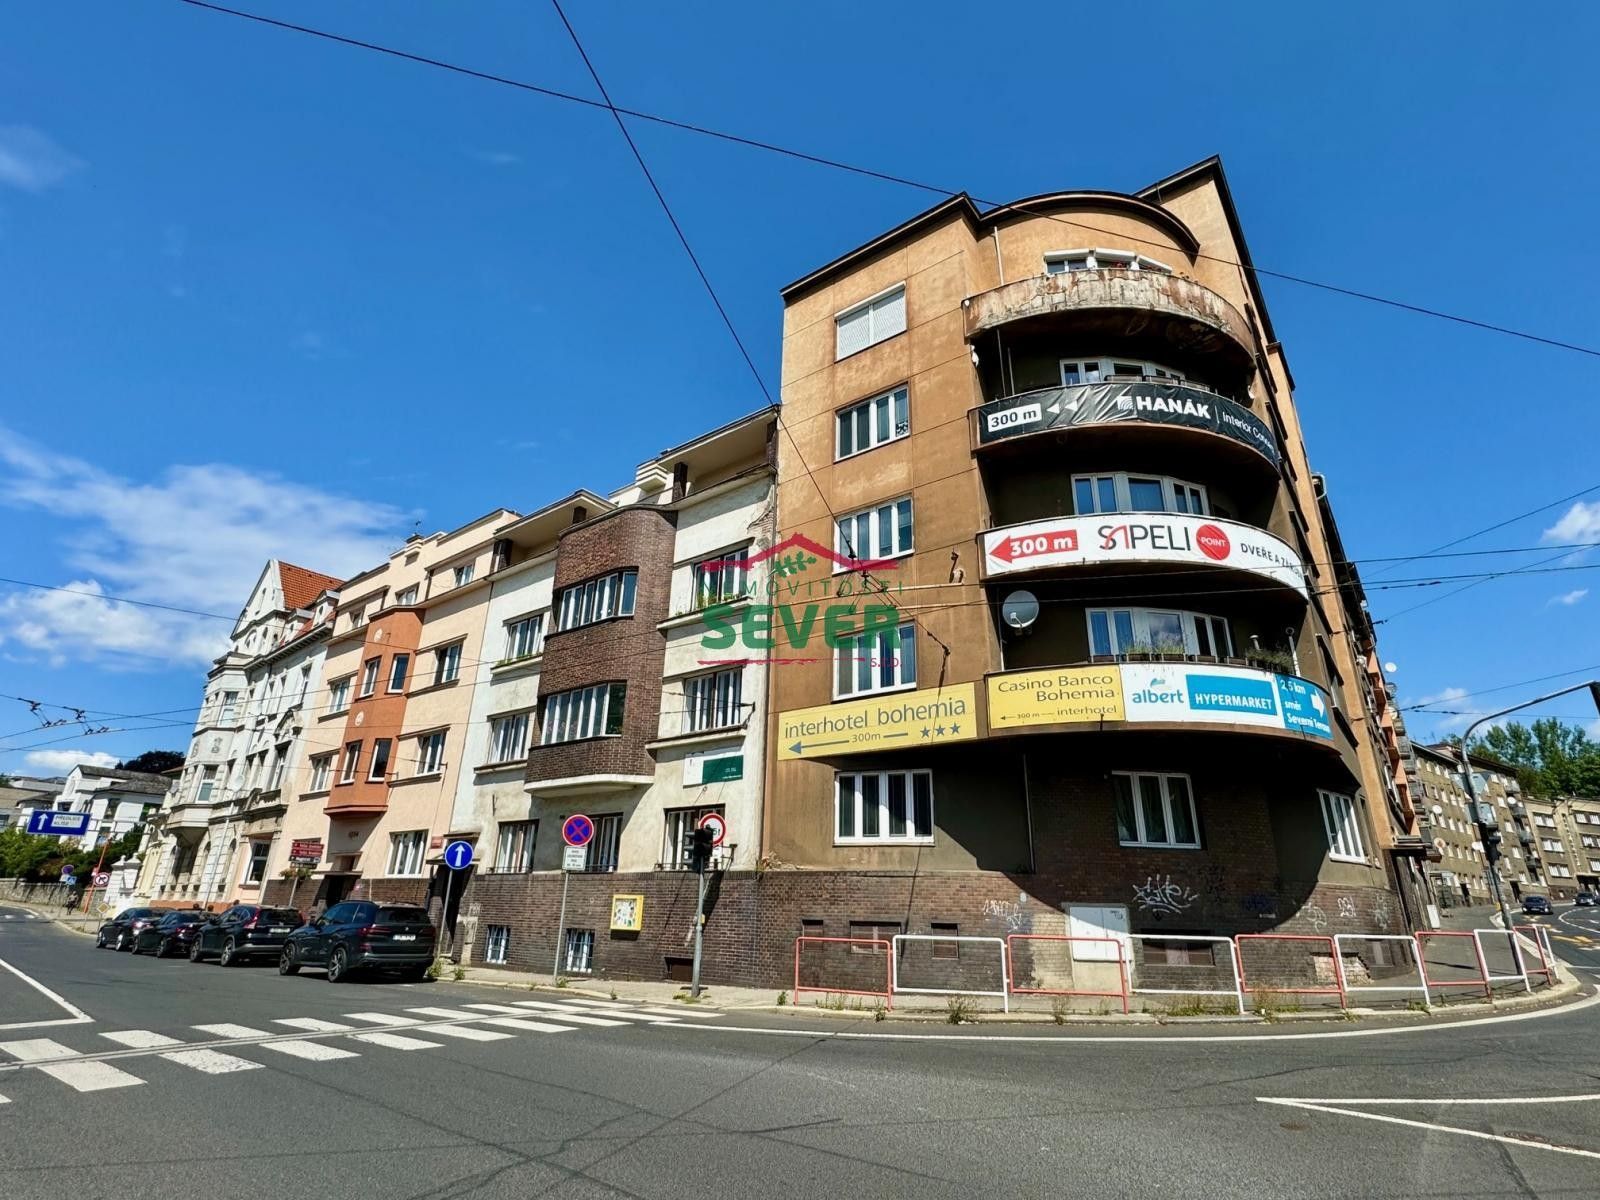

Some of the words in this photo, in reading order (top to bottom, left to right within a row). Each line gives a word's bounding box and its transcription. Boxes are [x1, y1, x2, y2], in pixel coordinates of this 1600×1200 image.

[991, 411, 1018, 428] 300
[1023, 408, 1037, 420] m
[1135, 395, 1211, 419] HANÁK
[1222, 411, 1252, 434] Interior
[1010, 538, 1047, 556] 300
[1053, 536, 1073, 550] m
[1200, 536, 1226, 548] POINT
[1240, 542, 1273, 561] DVEŘE
[1274, 554, 1281, 565] A
[997, 679, 1053, 694] Casino
[1057, 674, 1114, 688] Banco
[1293, 682, 1306, 695] km
[1036, 687, 1115, 702] Bohemia
[1131, 690, 1186, 704] albert
[1194, 692, 1273, 710] HYPERMARKET
[784, 710, 868, 738] interhotel
[877, 697, 966, 726] bohemia
[1056, 705, 1118, 717] interhotel
[851, 732, 881, 743] 300m
